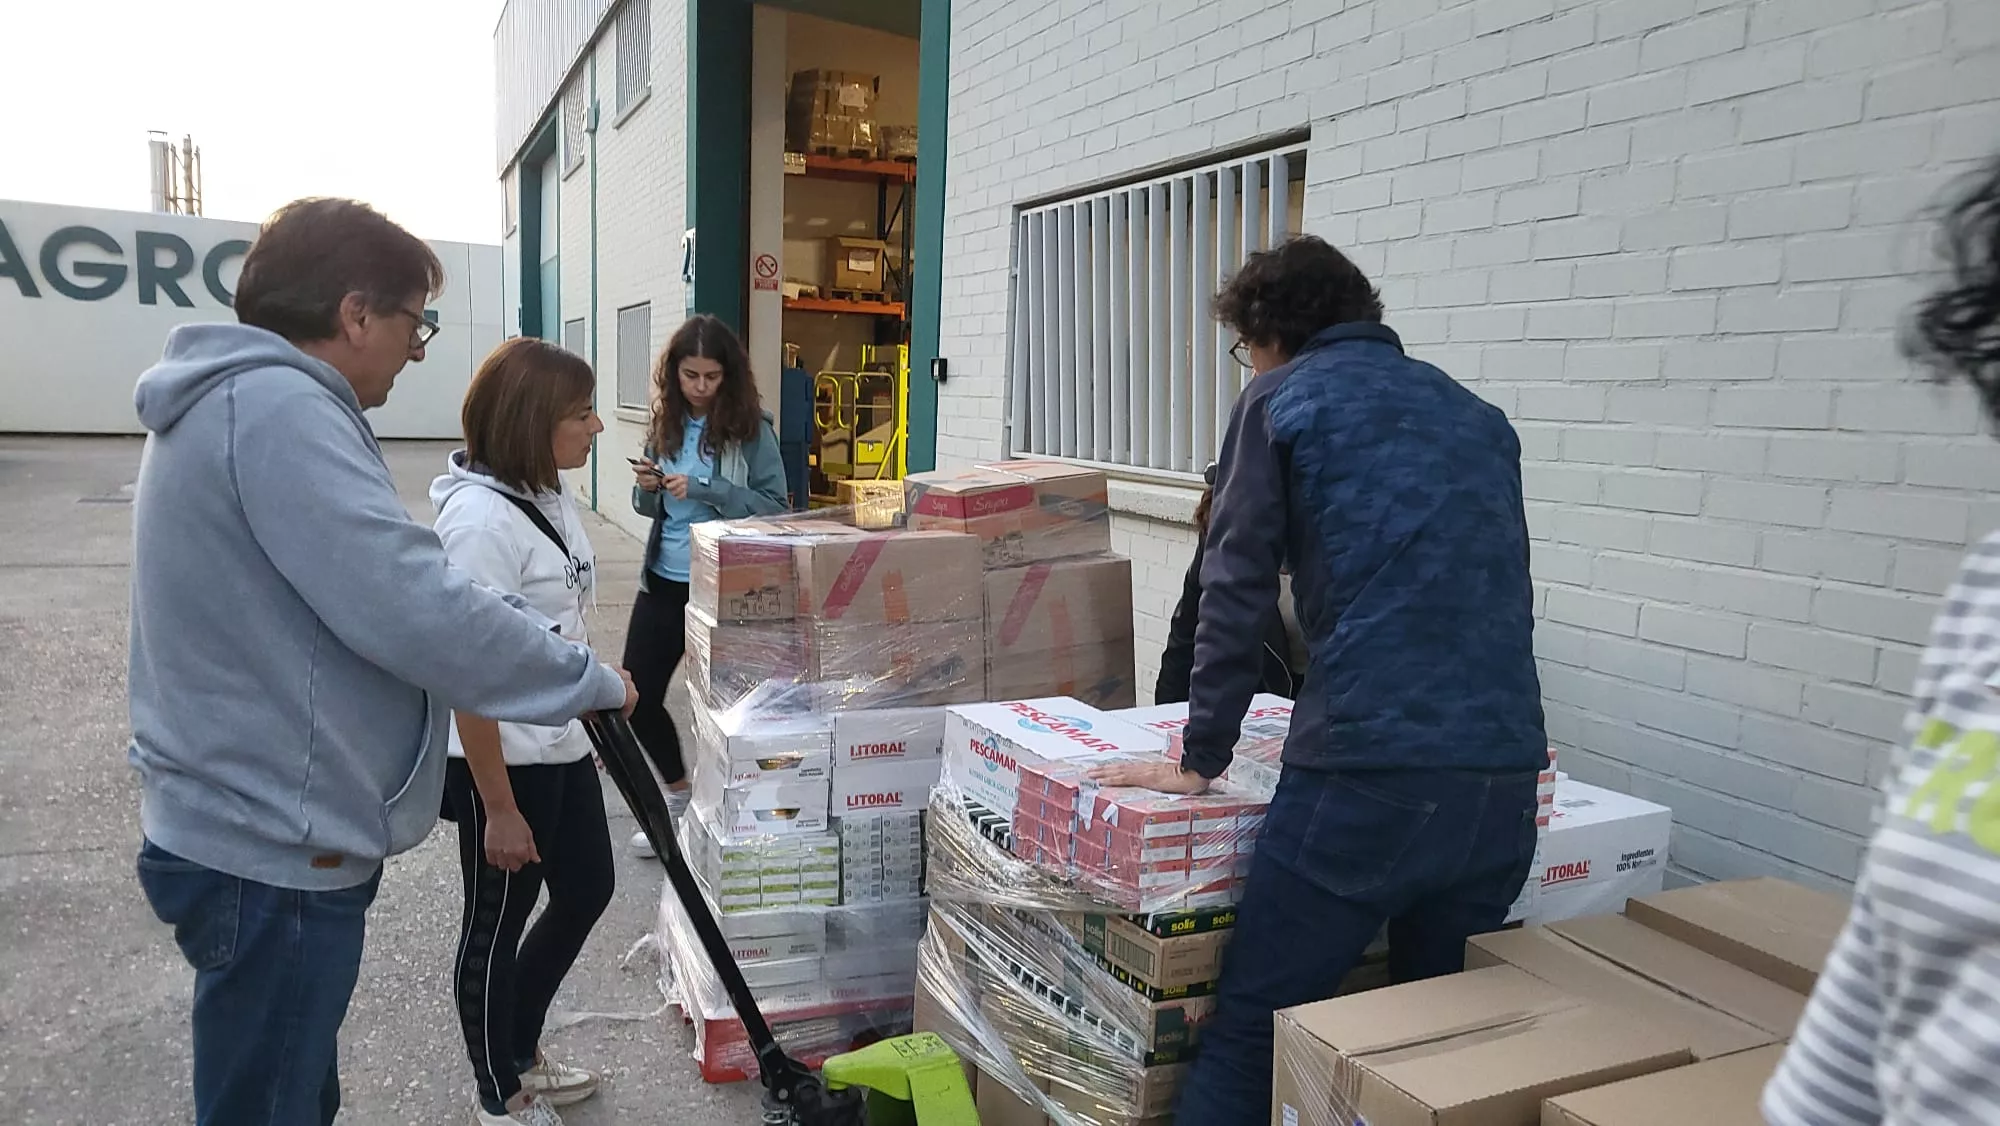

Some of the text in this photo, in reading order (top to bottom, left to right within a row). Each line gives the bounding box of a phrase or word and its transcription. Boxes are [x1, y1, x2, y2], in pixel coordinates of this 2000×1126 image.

[1000, 702, 1119, 752] PESCAMAR
[850, 741, 906, 757] LITORAL
[970, 738, 1017, 774] PESCAMAR
[847, 791, 903, 807] LITORAL
[1171, 918, 1196, 932] solis
[1212, 911, 1234, 926] solis
